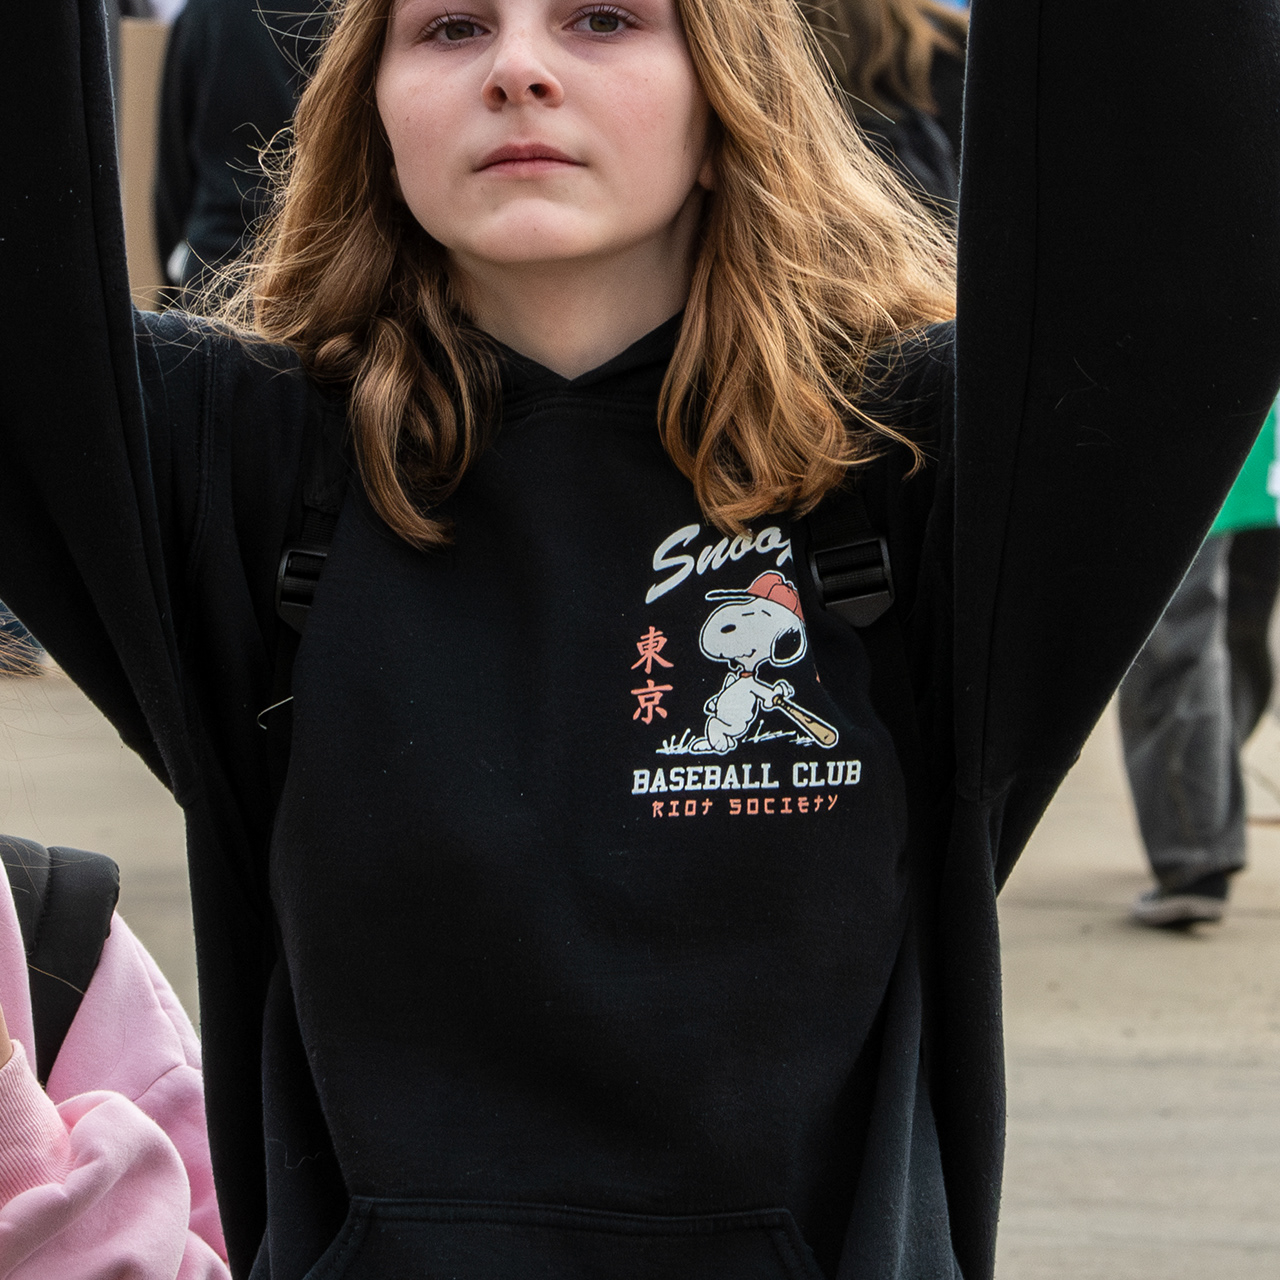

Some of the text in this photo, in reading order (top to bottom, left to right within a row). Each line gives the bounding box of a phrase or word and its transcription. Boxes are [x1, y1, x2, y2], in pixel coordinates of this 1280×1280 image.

[630, 625, 674, 725] 東京
[631, 759, 862, 795] BASEBALL CLUB
